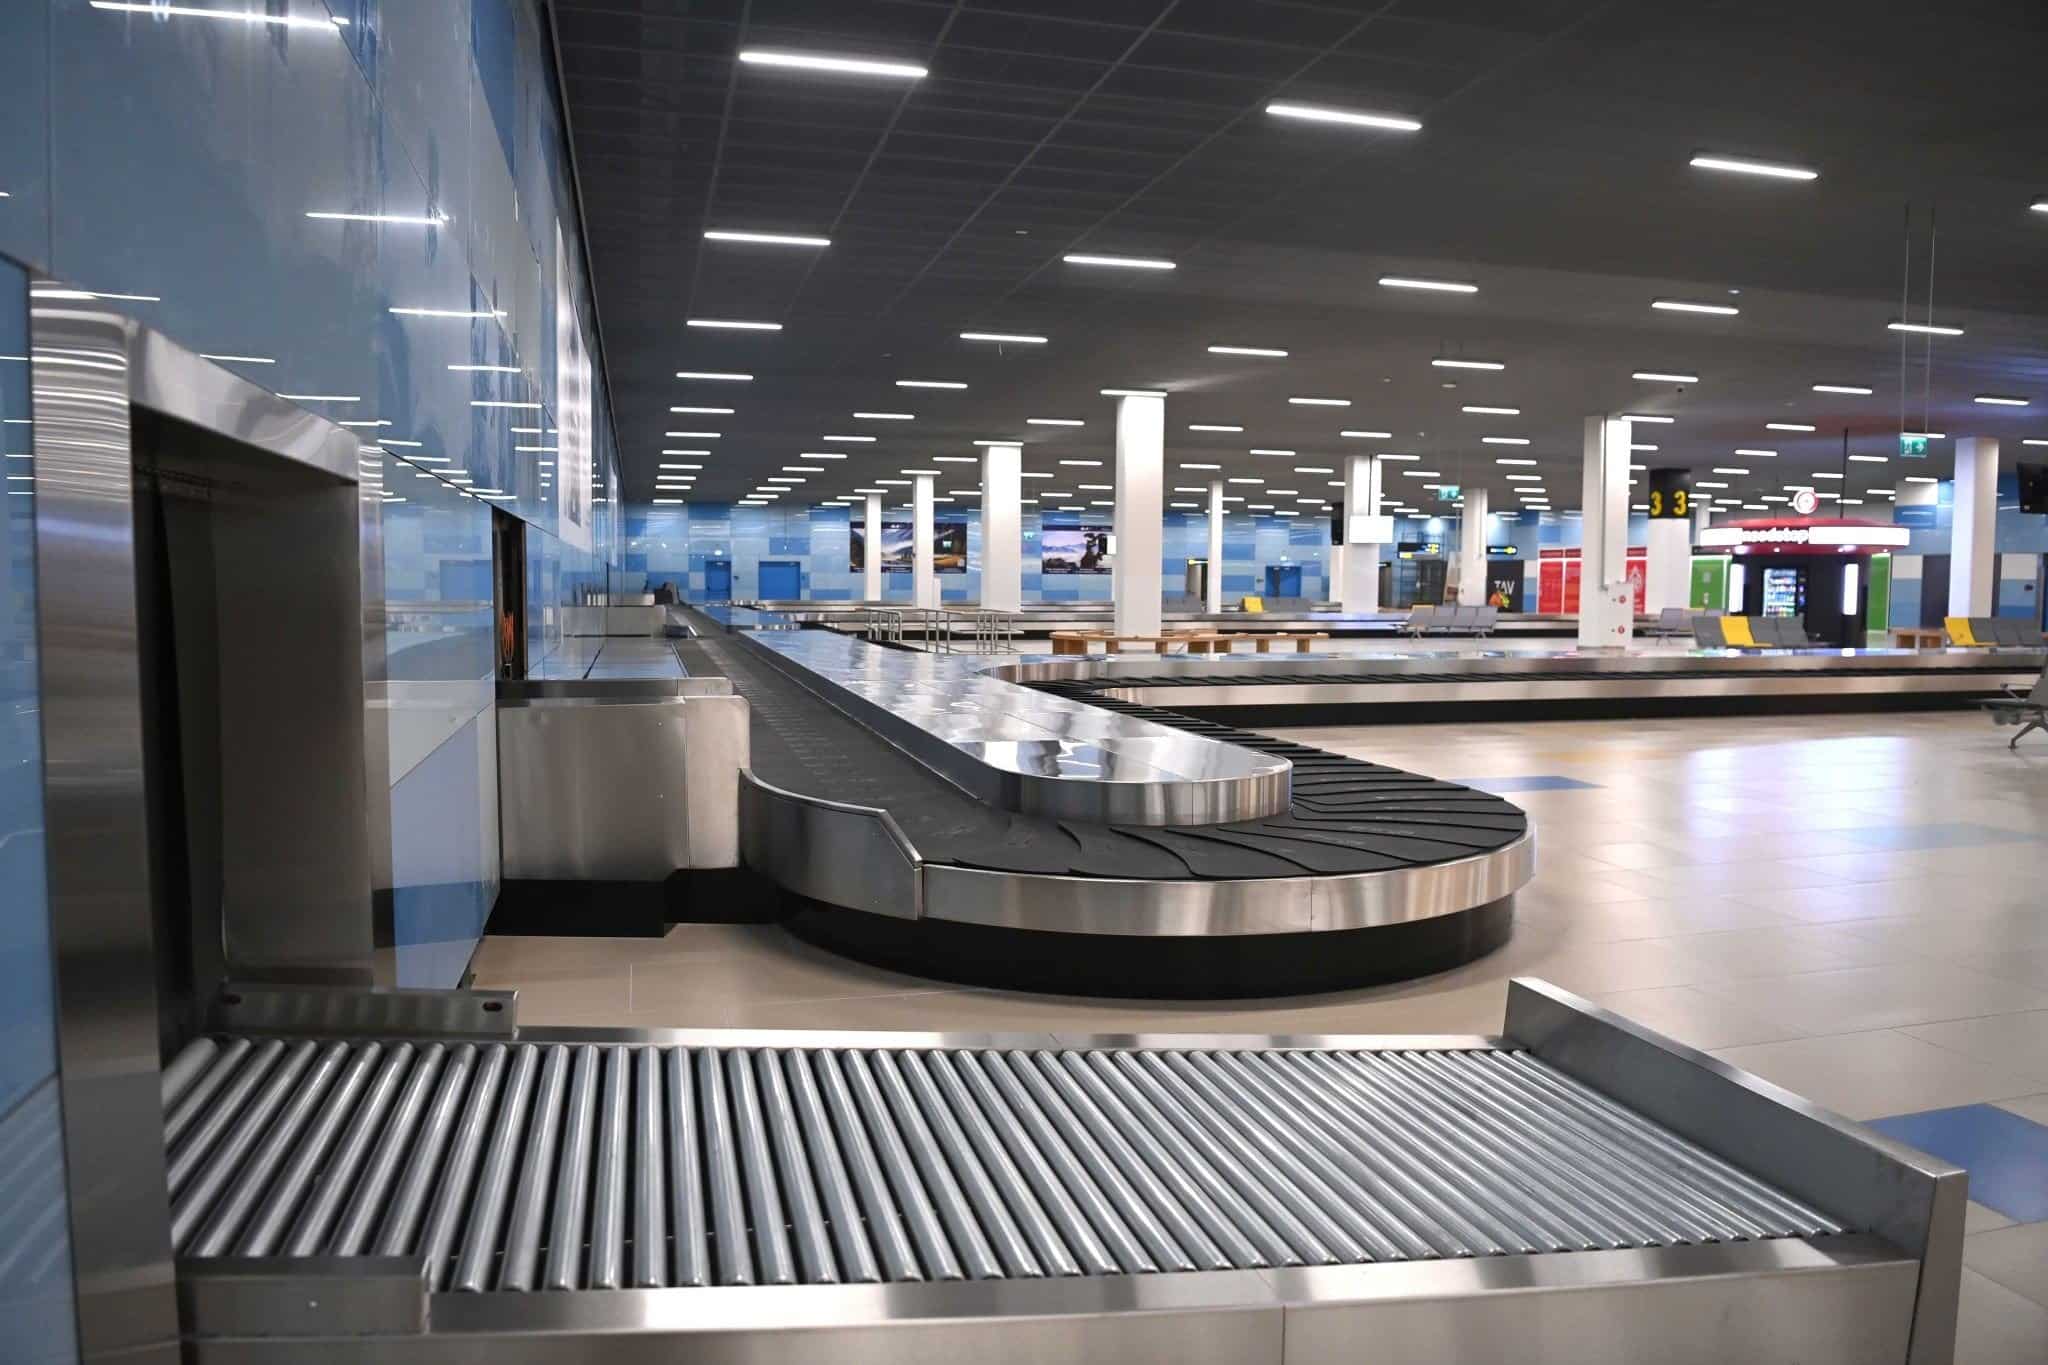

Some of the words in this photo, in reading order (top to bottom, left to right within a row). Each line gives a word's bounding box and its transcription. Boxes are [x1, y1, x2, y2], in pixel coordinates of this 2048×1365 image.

[1651, 490, 1662, 516] 3
[1673, 490, 1686, 515] 3
[1494, 580, 1515, 594] TAV
